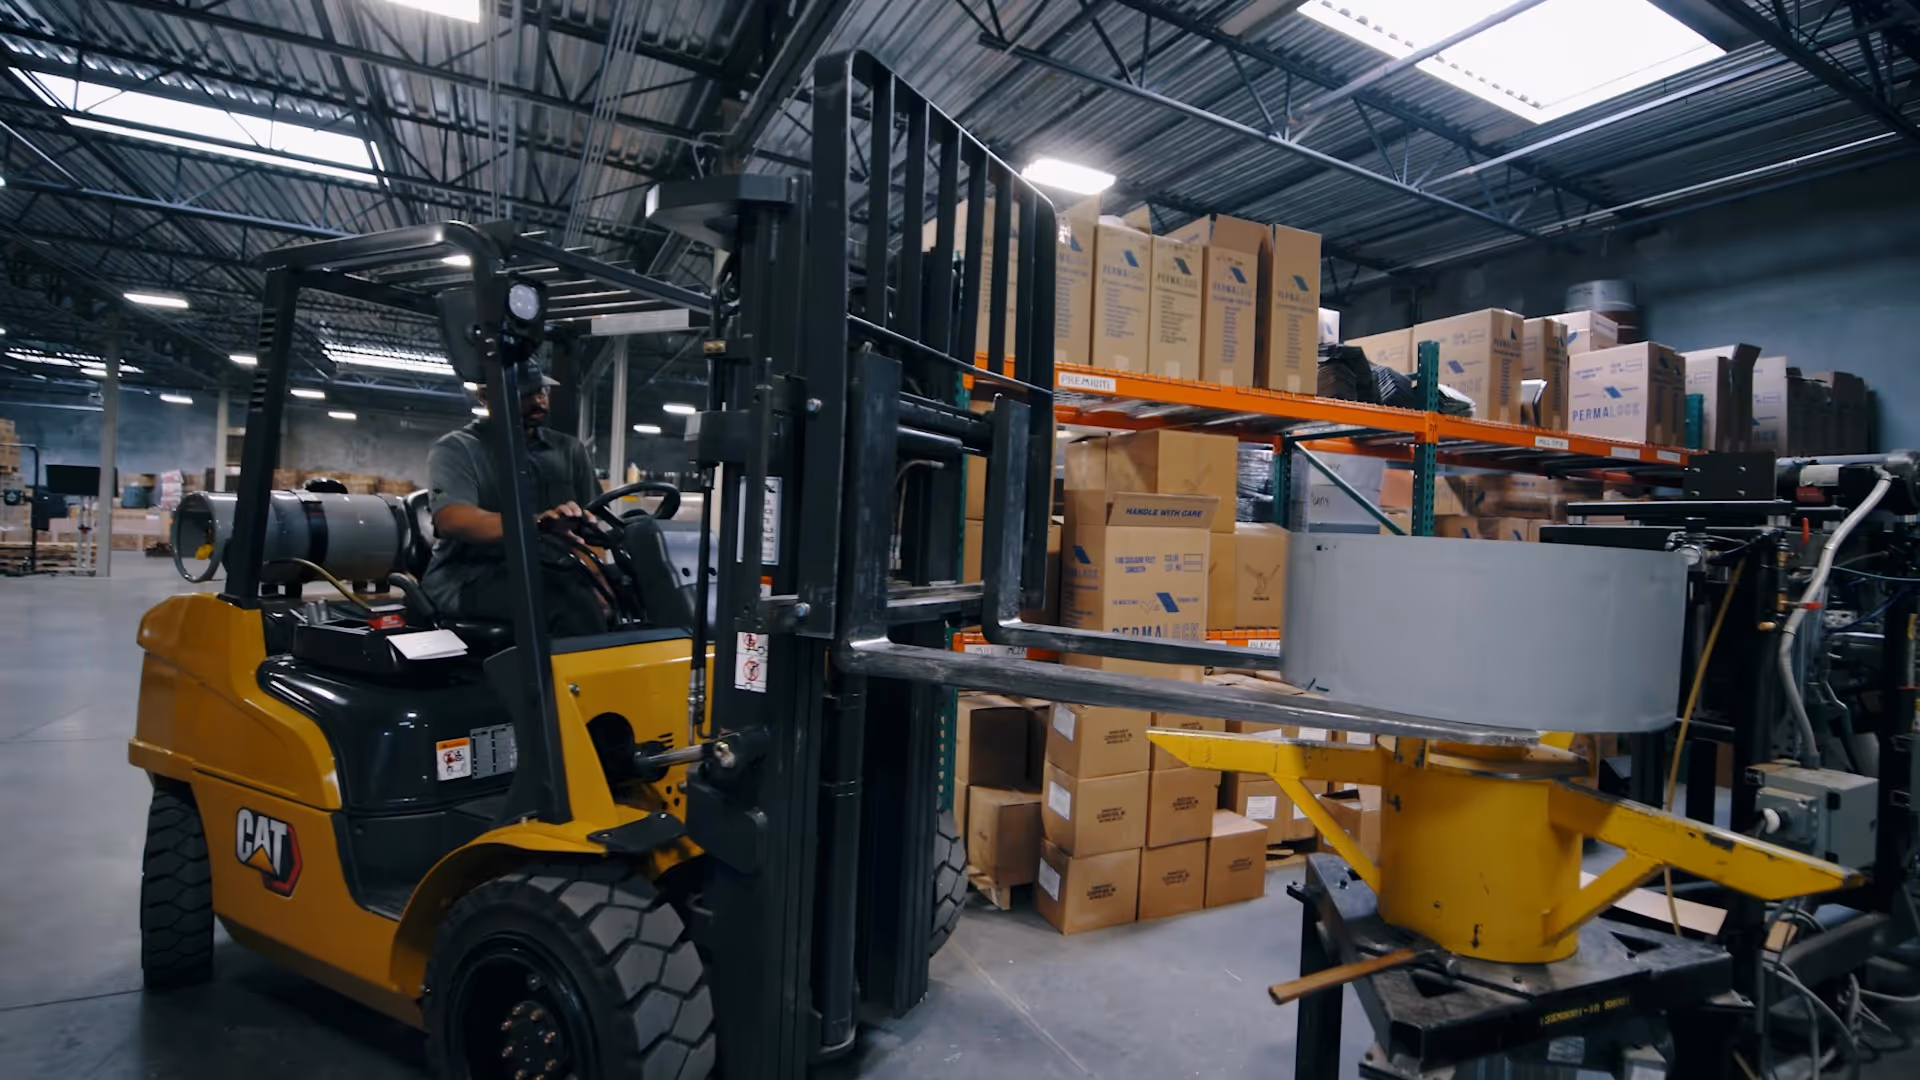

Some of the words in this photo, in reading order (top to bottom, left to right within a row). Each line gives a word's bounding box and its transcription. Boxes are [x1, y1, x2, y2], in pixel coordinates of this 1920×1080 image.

[1572, 402, 1640, 422] PERMALOCK
[1125, 507, 1158, 517] HANDLE
[1159, 508, 1181, 517] WITH
[1181, 509, 1203, 518] CARE
[236, 809, 289, 876] CAT
